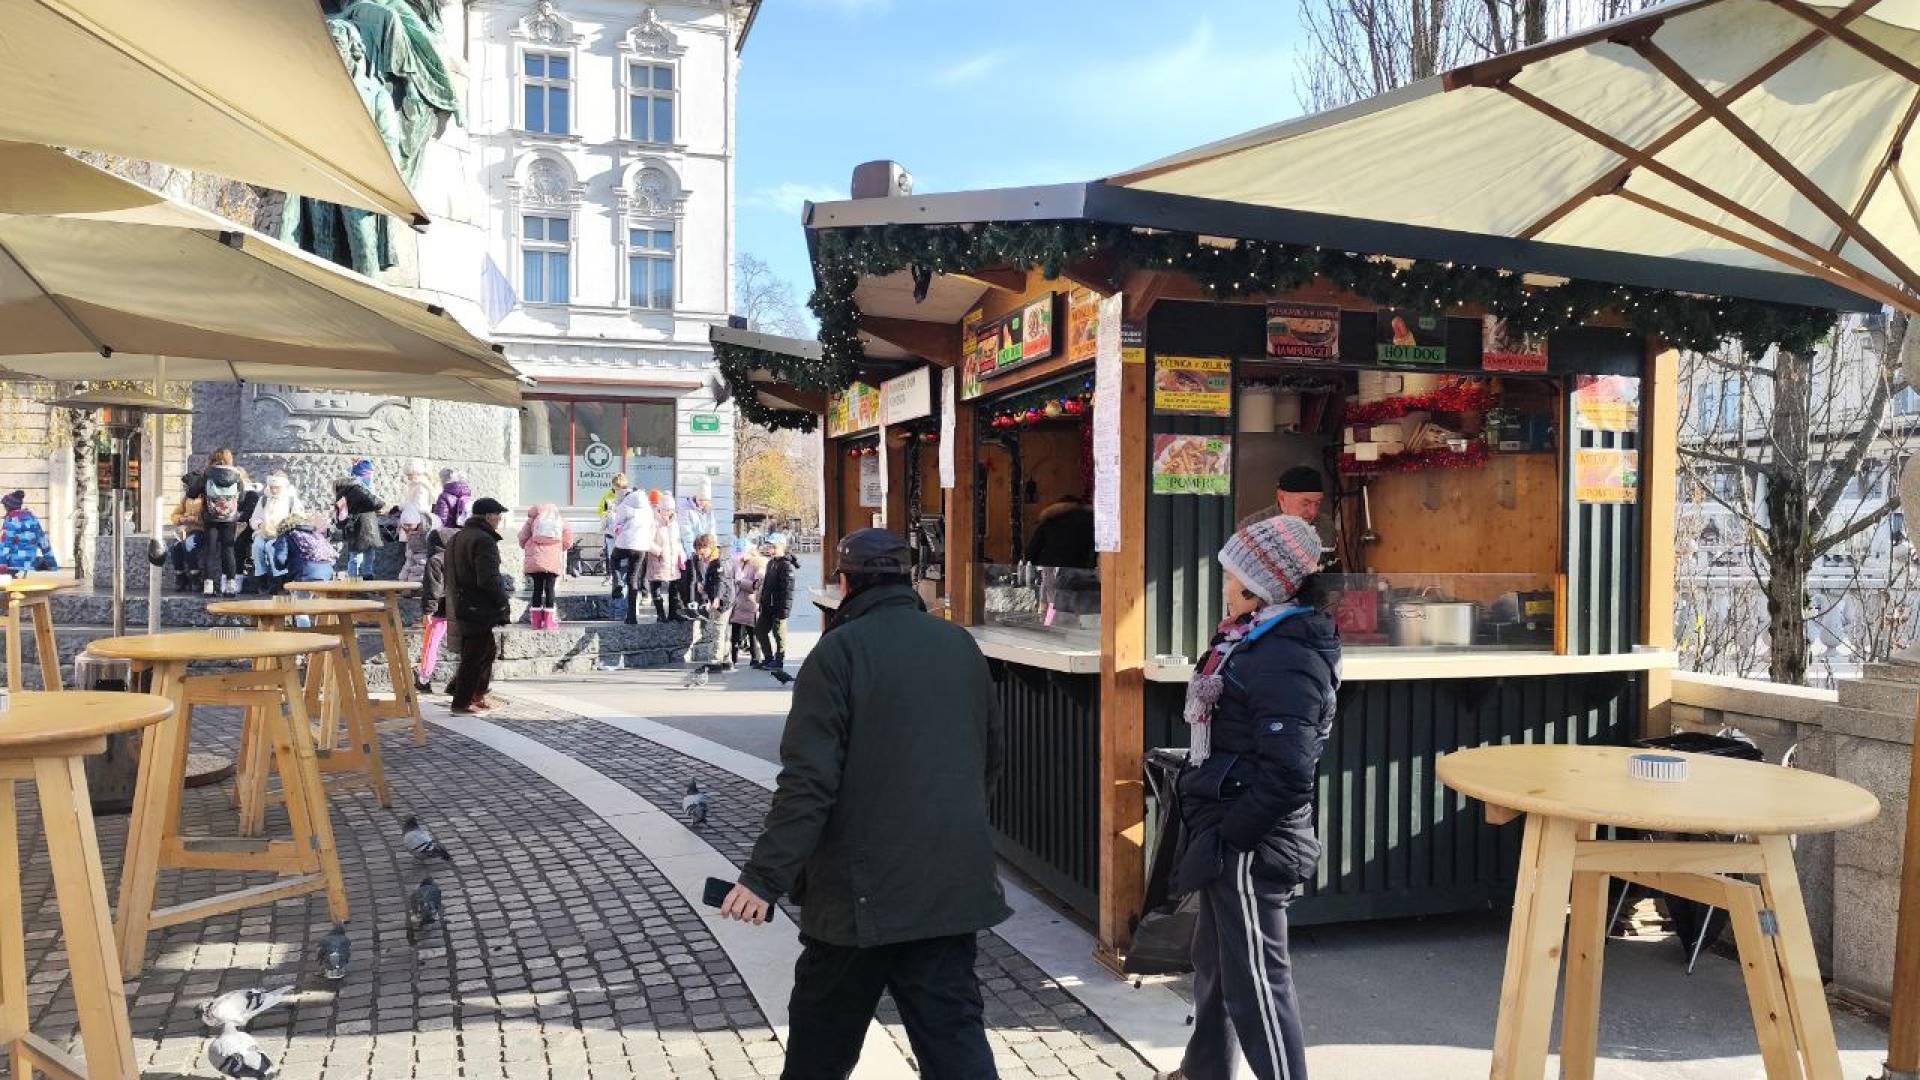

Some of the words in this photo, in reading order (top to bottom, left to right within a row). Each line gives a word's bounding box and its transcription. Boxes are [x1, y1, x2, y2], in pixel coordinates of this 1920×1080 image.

[1271, 344, 1333, 359] HAMBURGER
[1384, 345, 1409, 359] HOT
[1413, 347, 1441, 361] DOG
[580, 470, 615, 478] Lekarn
